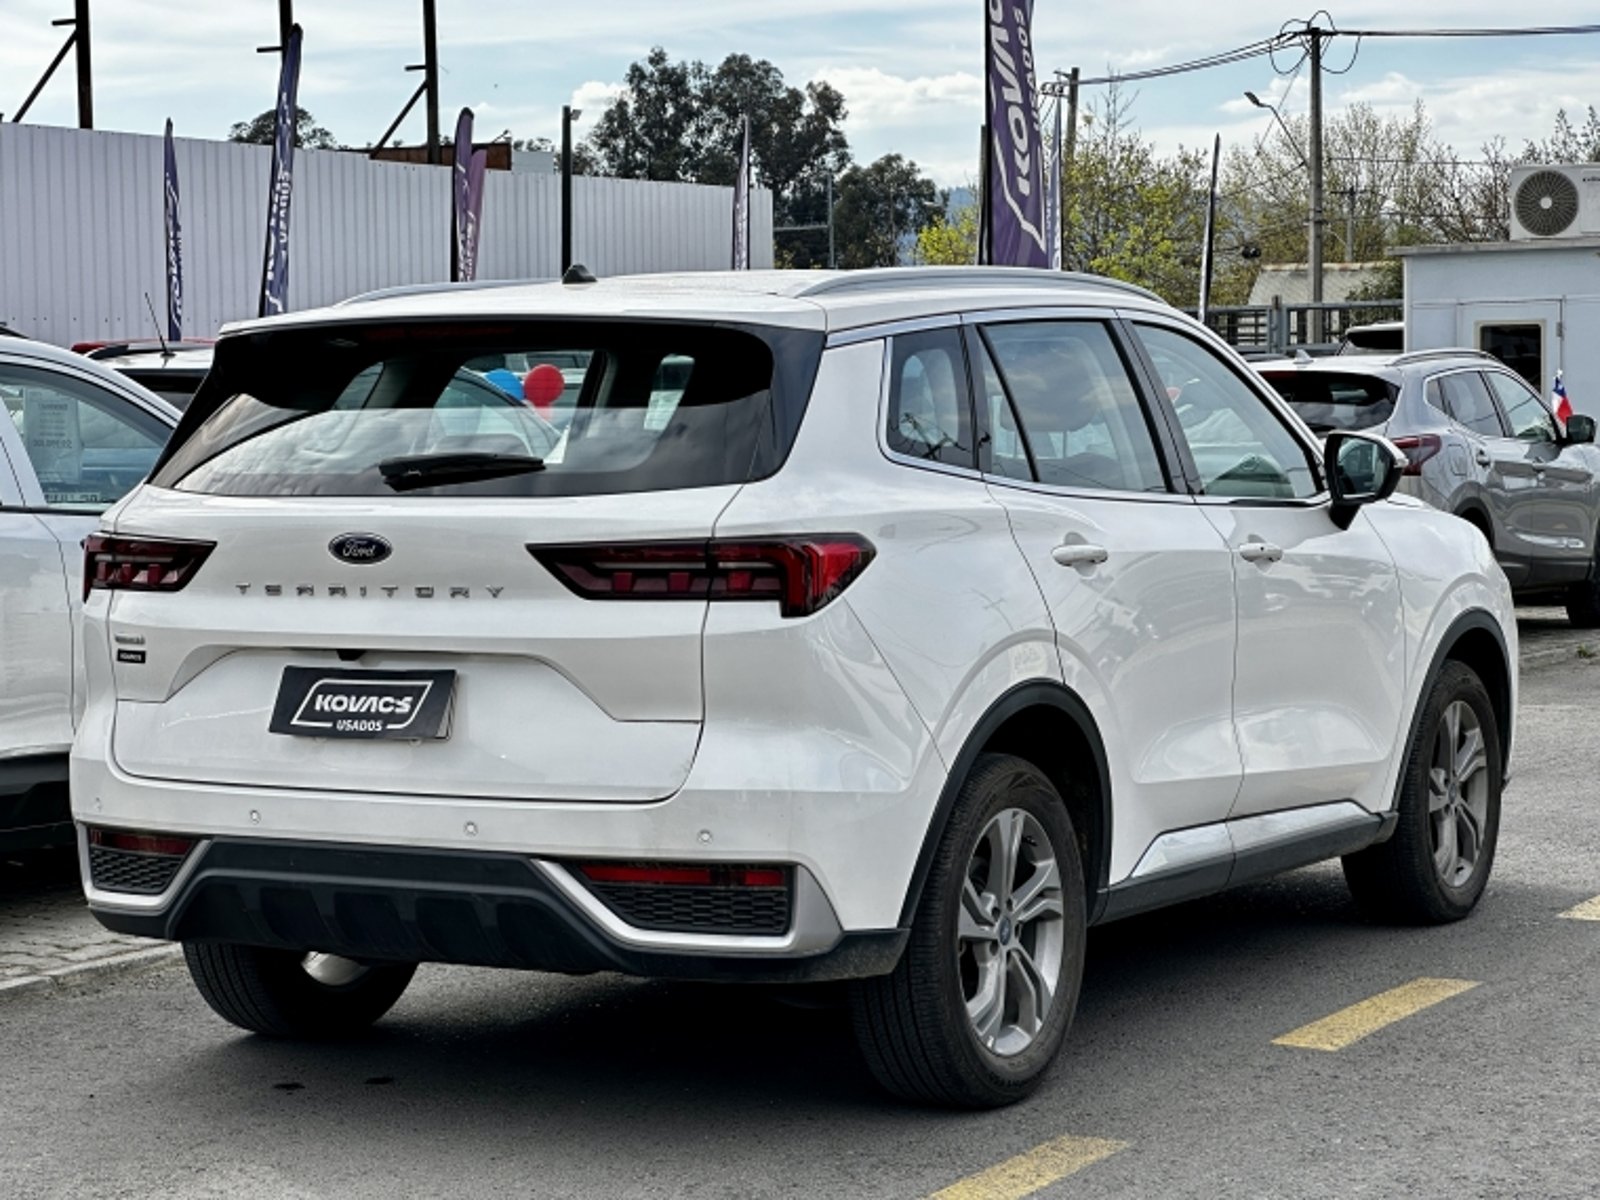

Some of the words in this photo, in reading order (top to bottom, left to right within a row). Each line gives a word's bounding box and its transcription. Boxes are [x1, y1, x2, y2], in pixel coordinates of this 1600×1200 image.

[1013, 6, 1040, 131] USADOS
[343, 539, 376, 557] Ford
[236, 584, 504, 599] TERRITORY
[314, 694, 413, 714] KOVACS
[336, 719, 382, 732] USADOS
